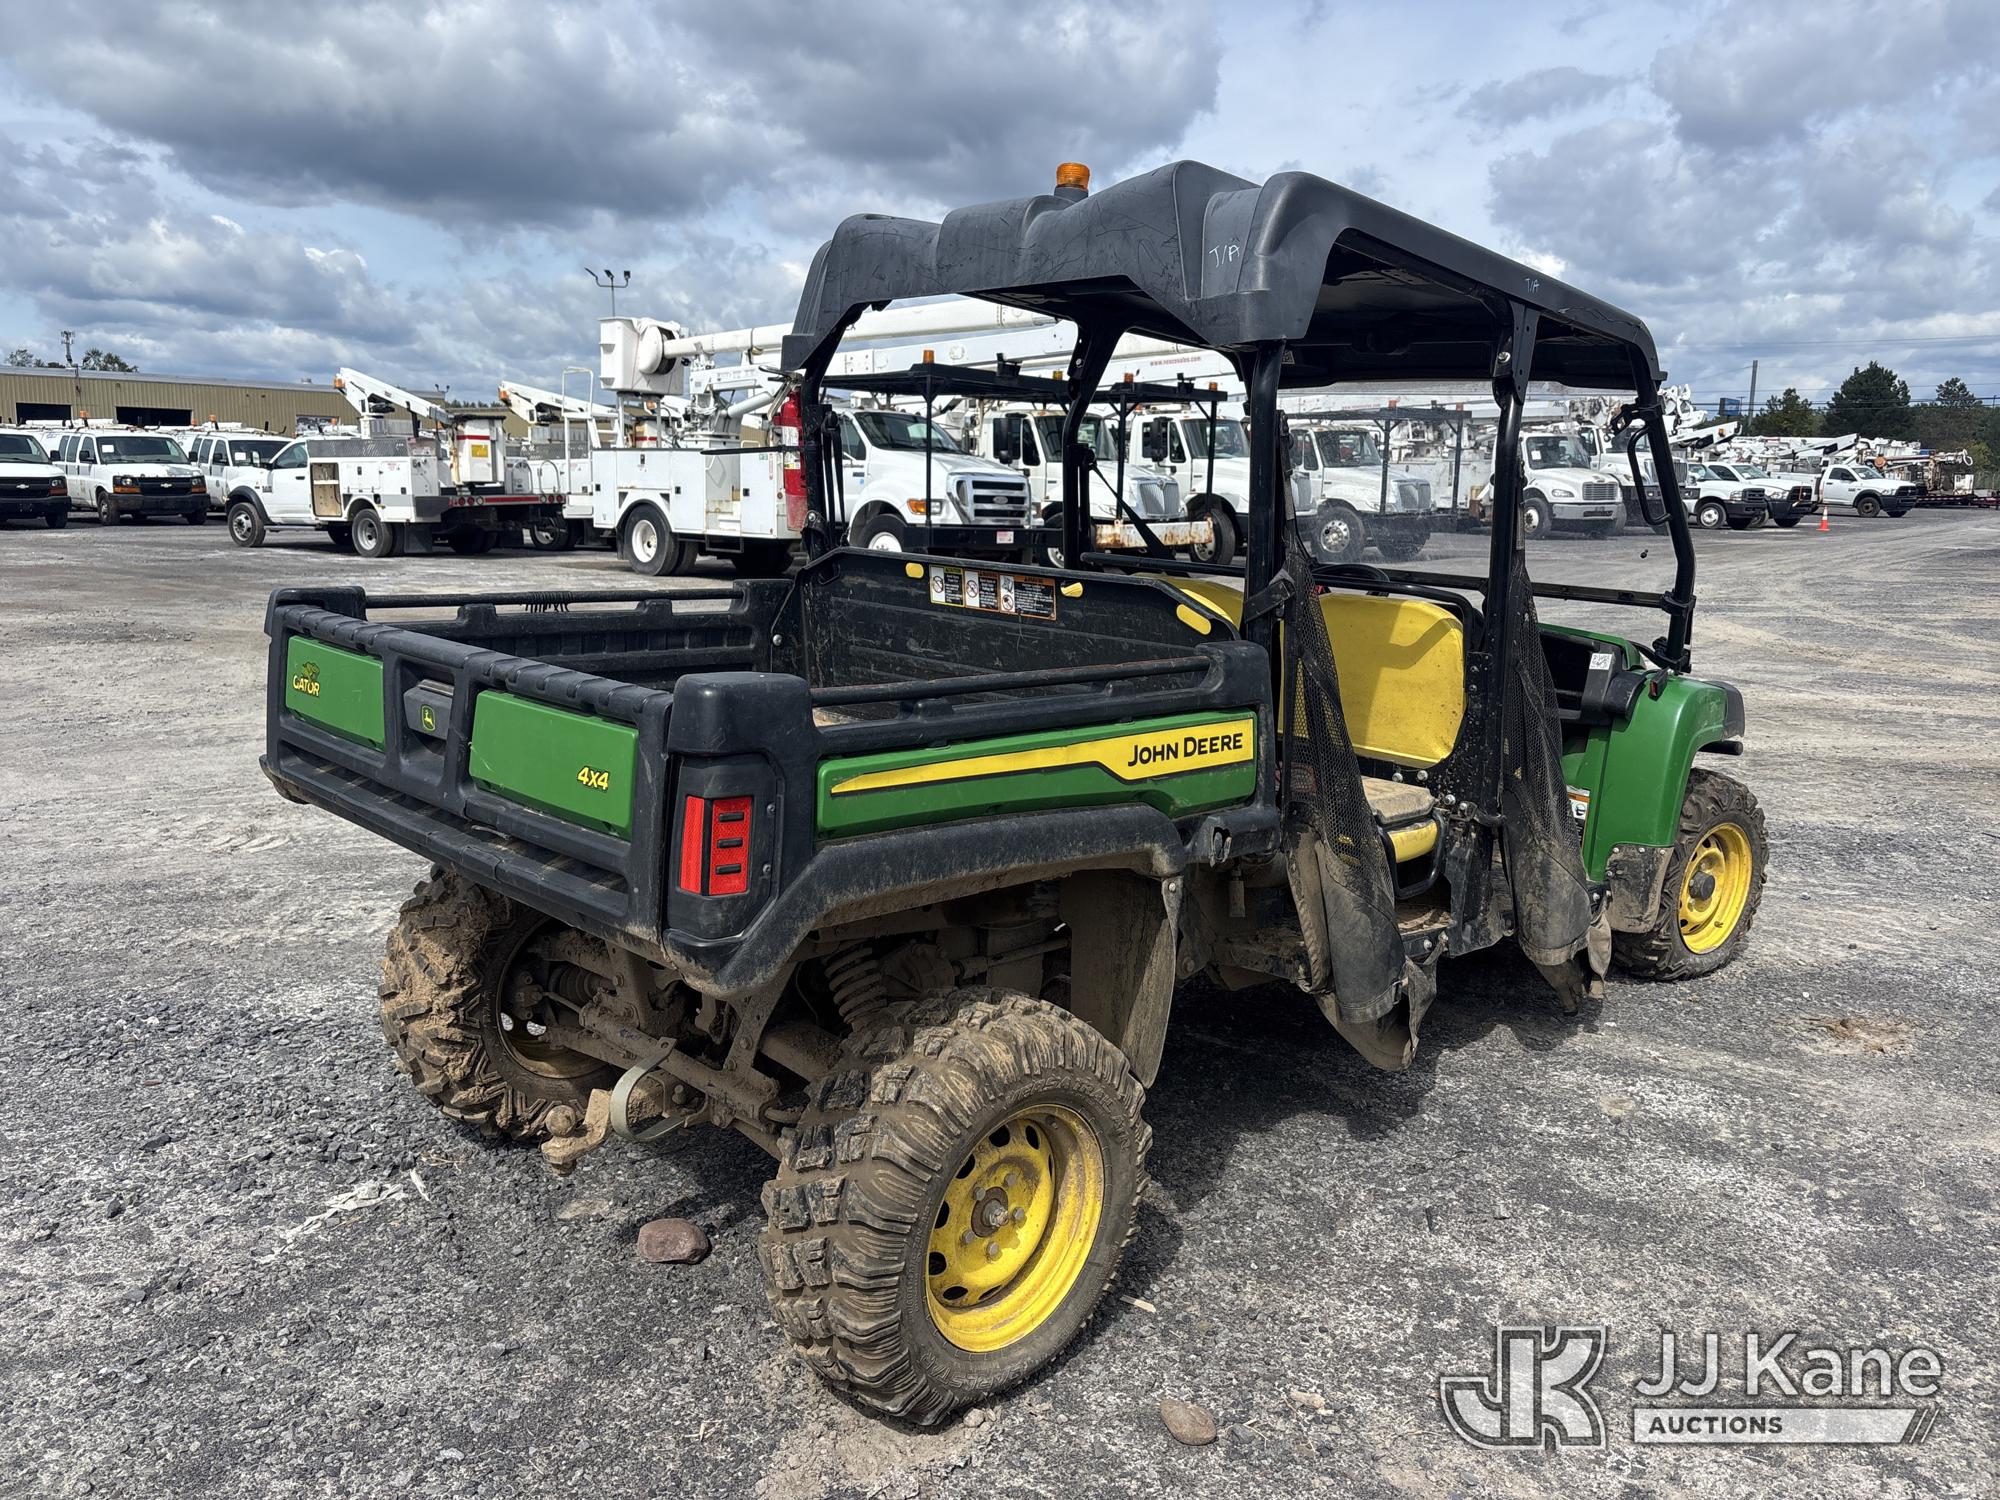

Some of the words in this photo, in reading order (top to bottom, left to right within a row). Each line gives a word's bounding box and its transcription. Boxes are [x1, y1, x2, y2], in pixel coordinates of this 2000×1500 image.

[292, 674, 320, 697] GATOR
[1128, 742, 1179, 767] JOHN
[1183, 732, 1243, 758] DEERE
